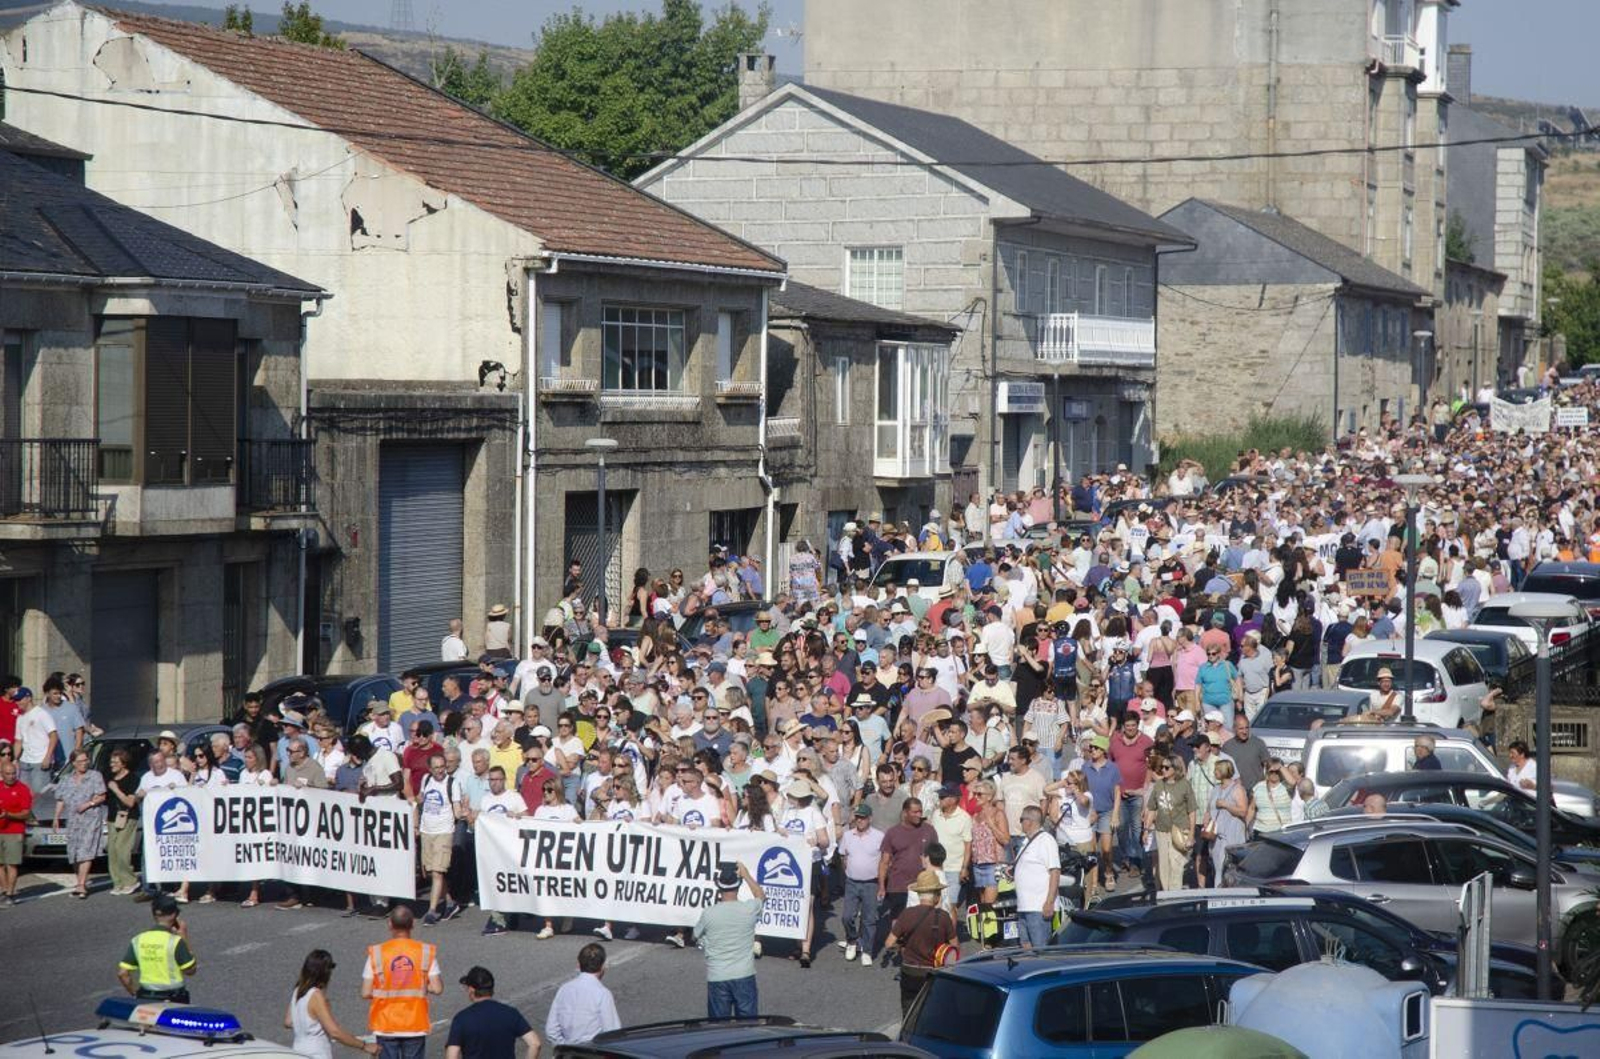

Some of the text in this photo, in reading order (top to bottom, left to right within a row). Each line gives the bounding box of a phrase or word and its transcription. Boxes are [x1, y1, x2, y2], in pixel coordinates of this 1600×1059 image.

[213, 795, 410, 850] DEREITO AO TREN
[518, 828, 596, 873] TREN
[606, 823, 668, 877] ÚTIL
[160, 858, 197, 872] AO TREN
[331, 849, 346, 872] EN
[349, 853, 377, 877] VIDA
[496, 871, 530, 894] SEN
[533, 875, 587, 900] TREN
[594, 878, 608, 900] O
[614, 879, 668, 906] RURAL
[764, 886, 805, 899] ATAFORMA
[763, 897, 801, 913] EREITO
[773, 912, 799, 929] TREN
